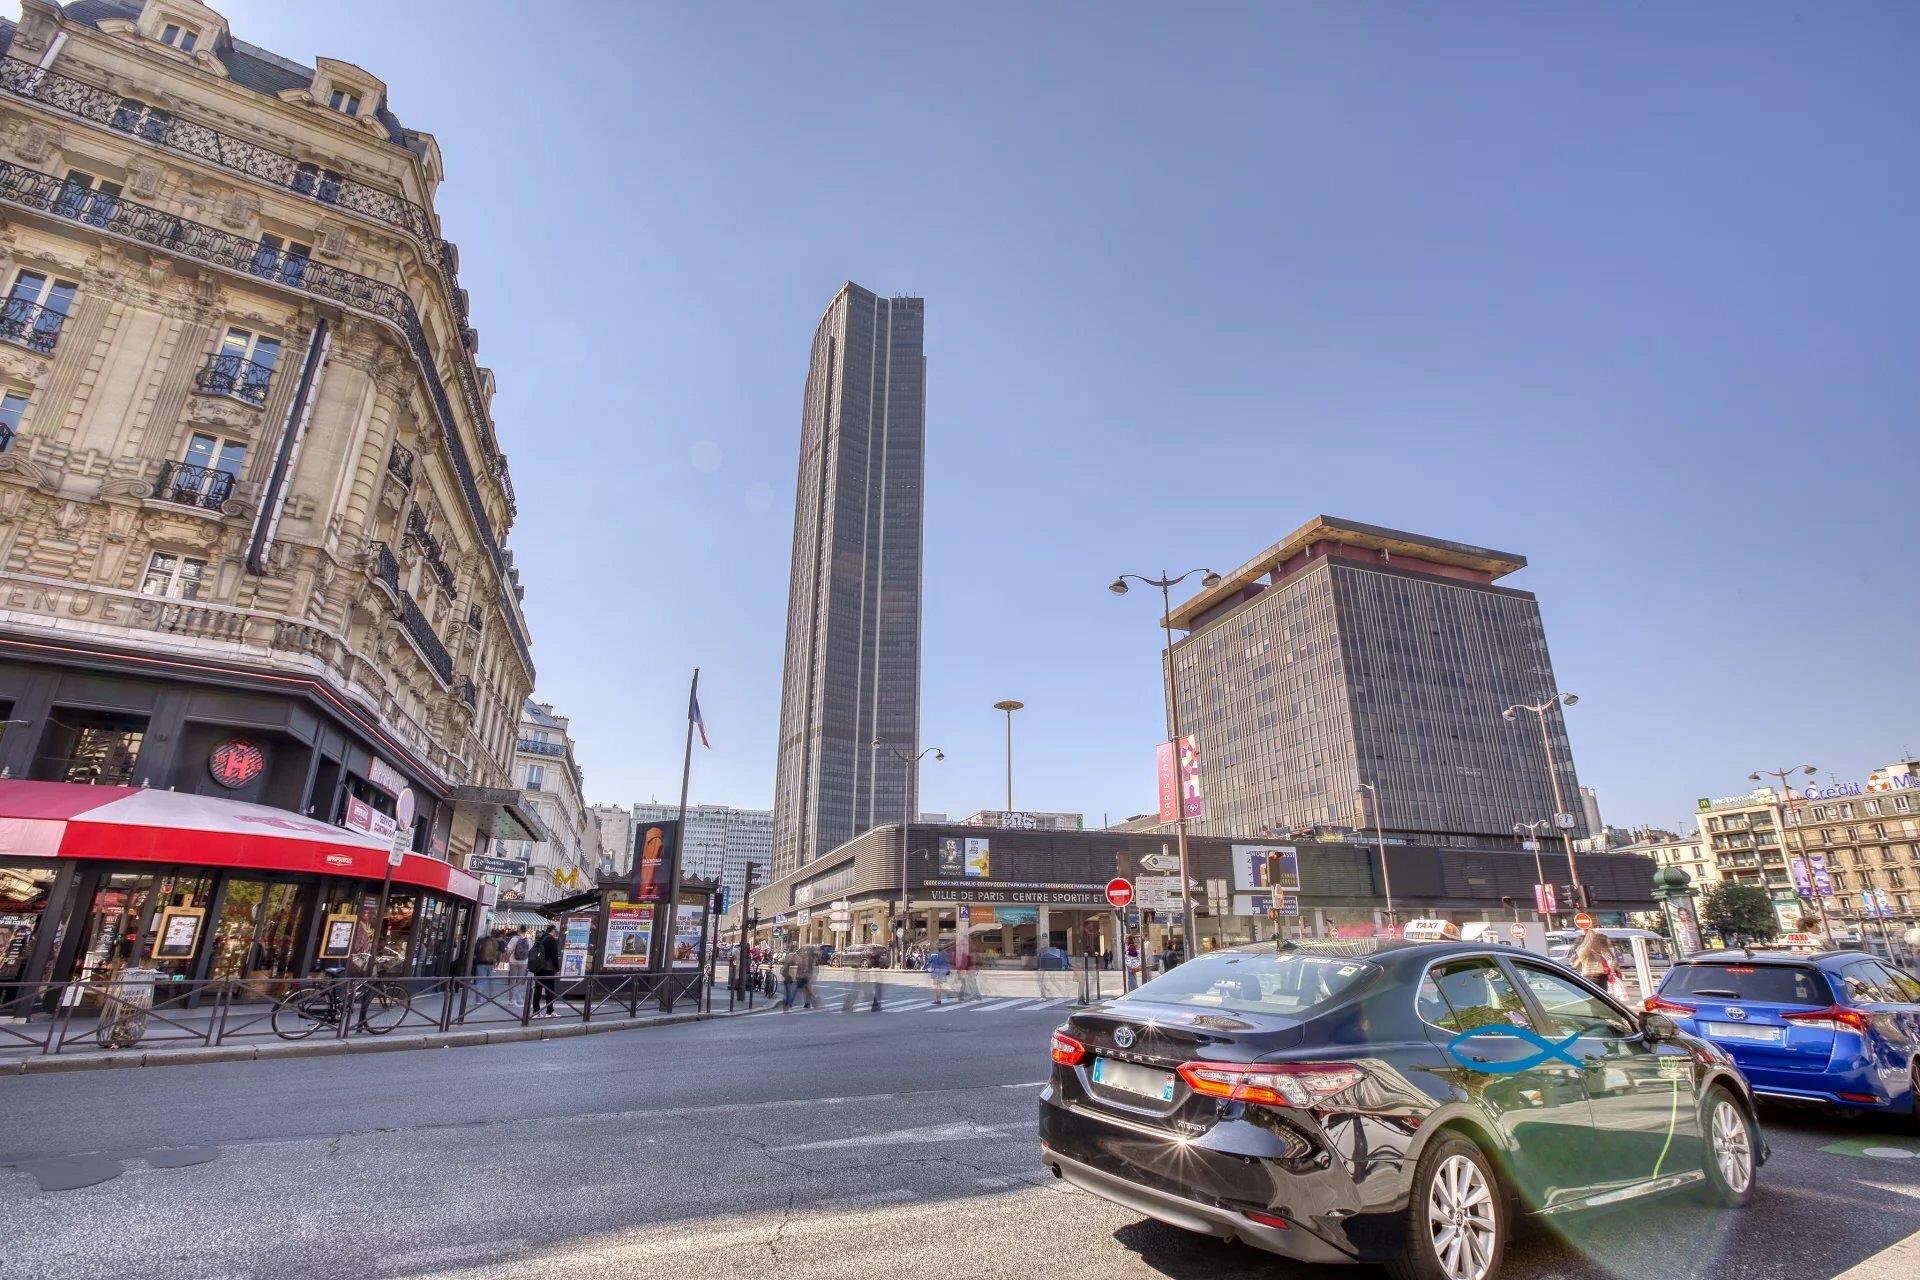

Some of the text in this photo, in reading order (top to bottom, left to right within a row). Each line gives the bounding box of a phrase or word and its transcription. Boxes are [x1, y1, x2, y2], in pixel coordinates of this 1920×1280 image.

[1162, 749, 1170, 778] 2024
[1805, 782, 1861, 801] Crédit
[553, 867, 579, 890] M
[932, 891, 1104, 902] VILLE DE PARIS CENTRE SPORTIF ET
[1095, 1047, 1159, 1063] CAMRY
